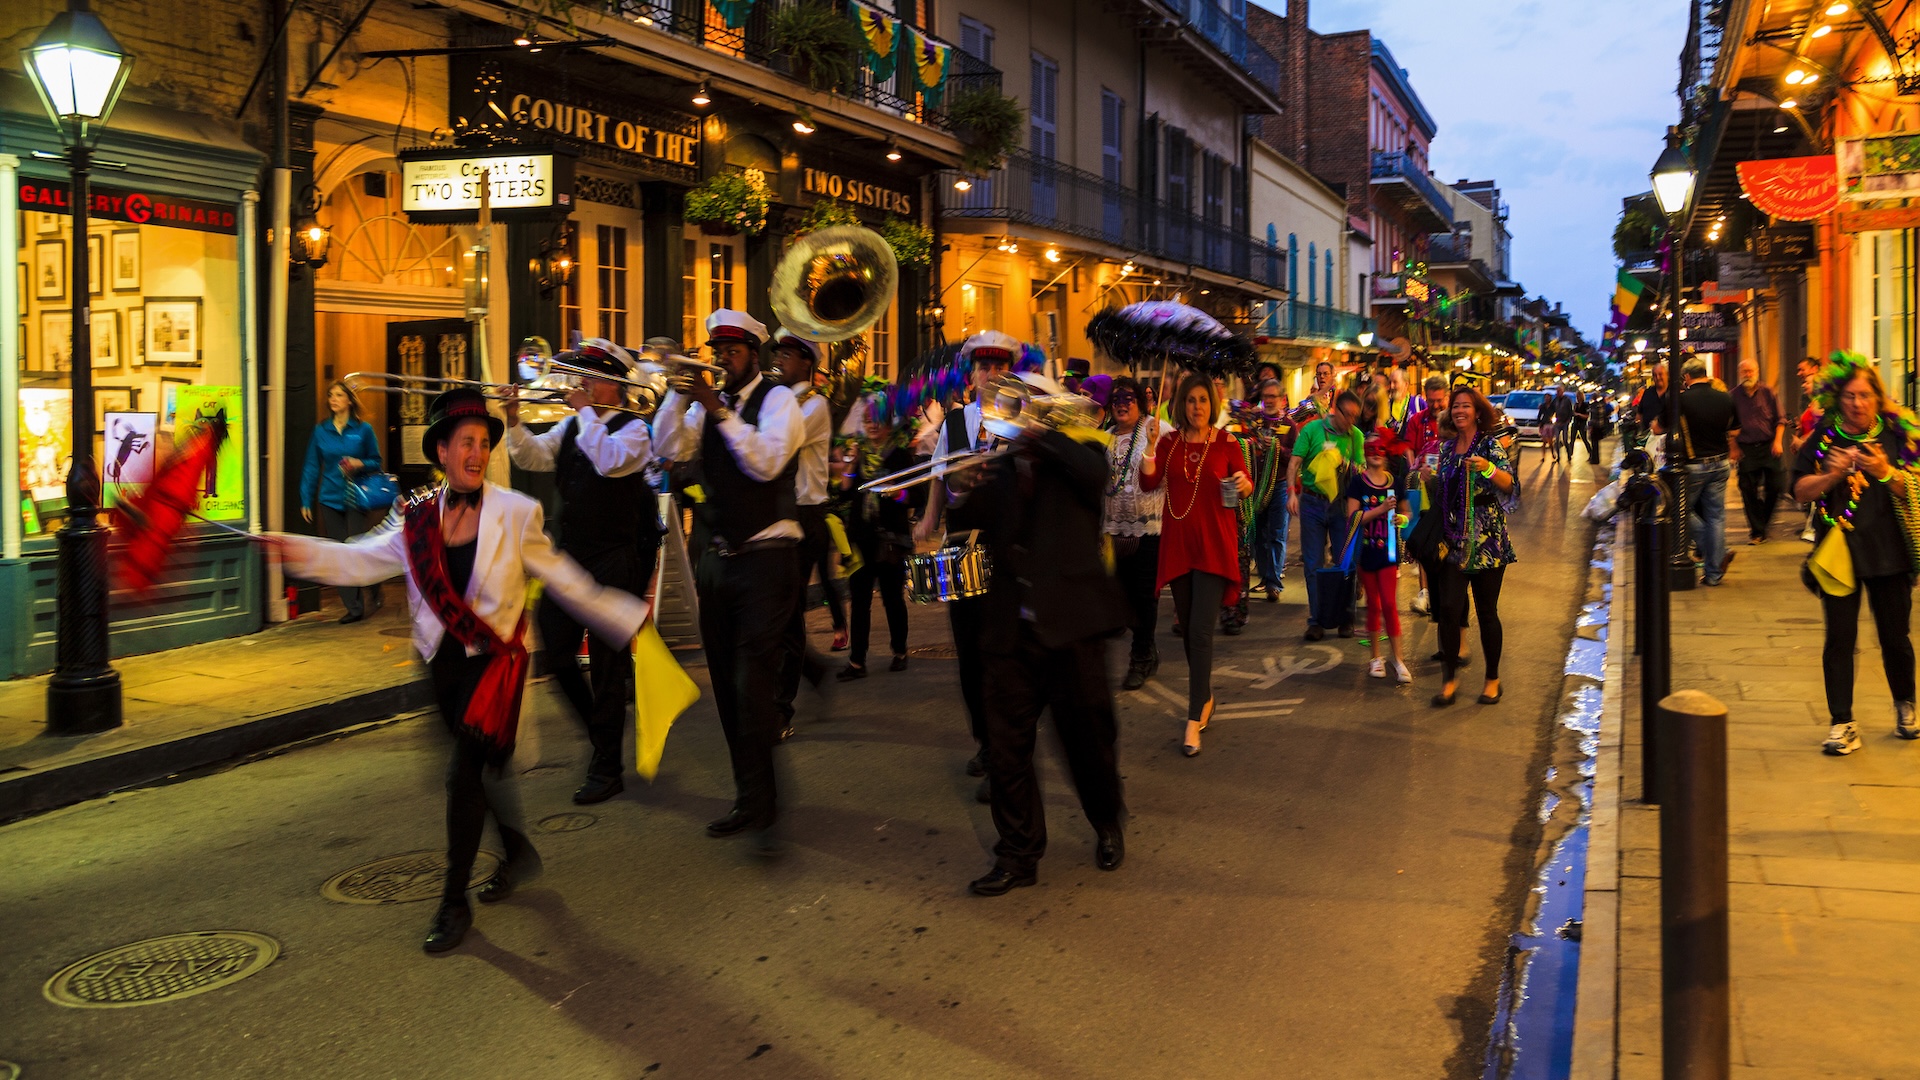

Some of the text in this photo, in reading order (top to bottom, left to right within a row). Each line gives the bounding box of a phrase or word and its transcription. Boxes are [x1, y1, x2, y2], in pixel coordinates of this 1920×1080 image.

[511, 94, 700, 166] COURT OF THE
[461, 159, 535, 178] Court of
[410, 182, 453, 201] TWO
[804, 167, 911, 215] TWO SISTERS
[203, 401, 218, 409] CAT
[73, 954, 248, 981] WATER
